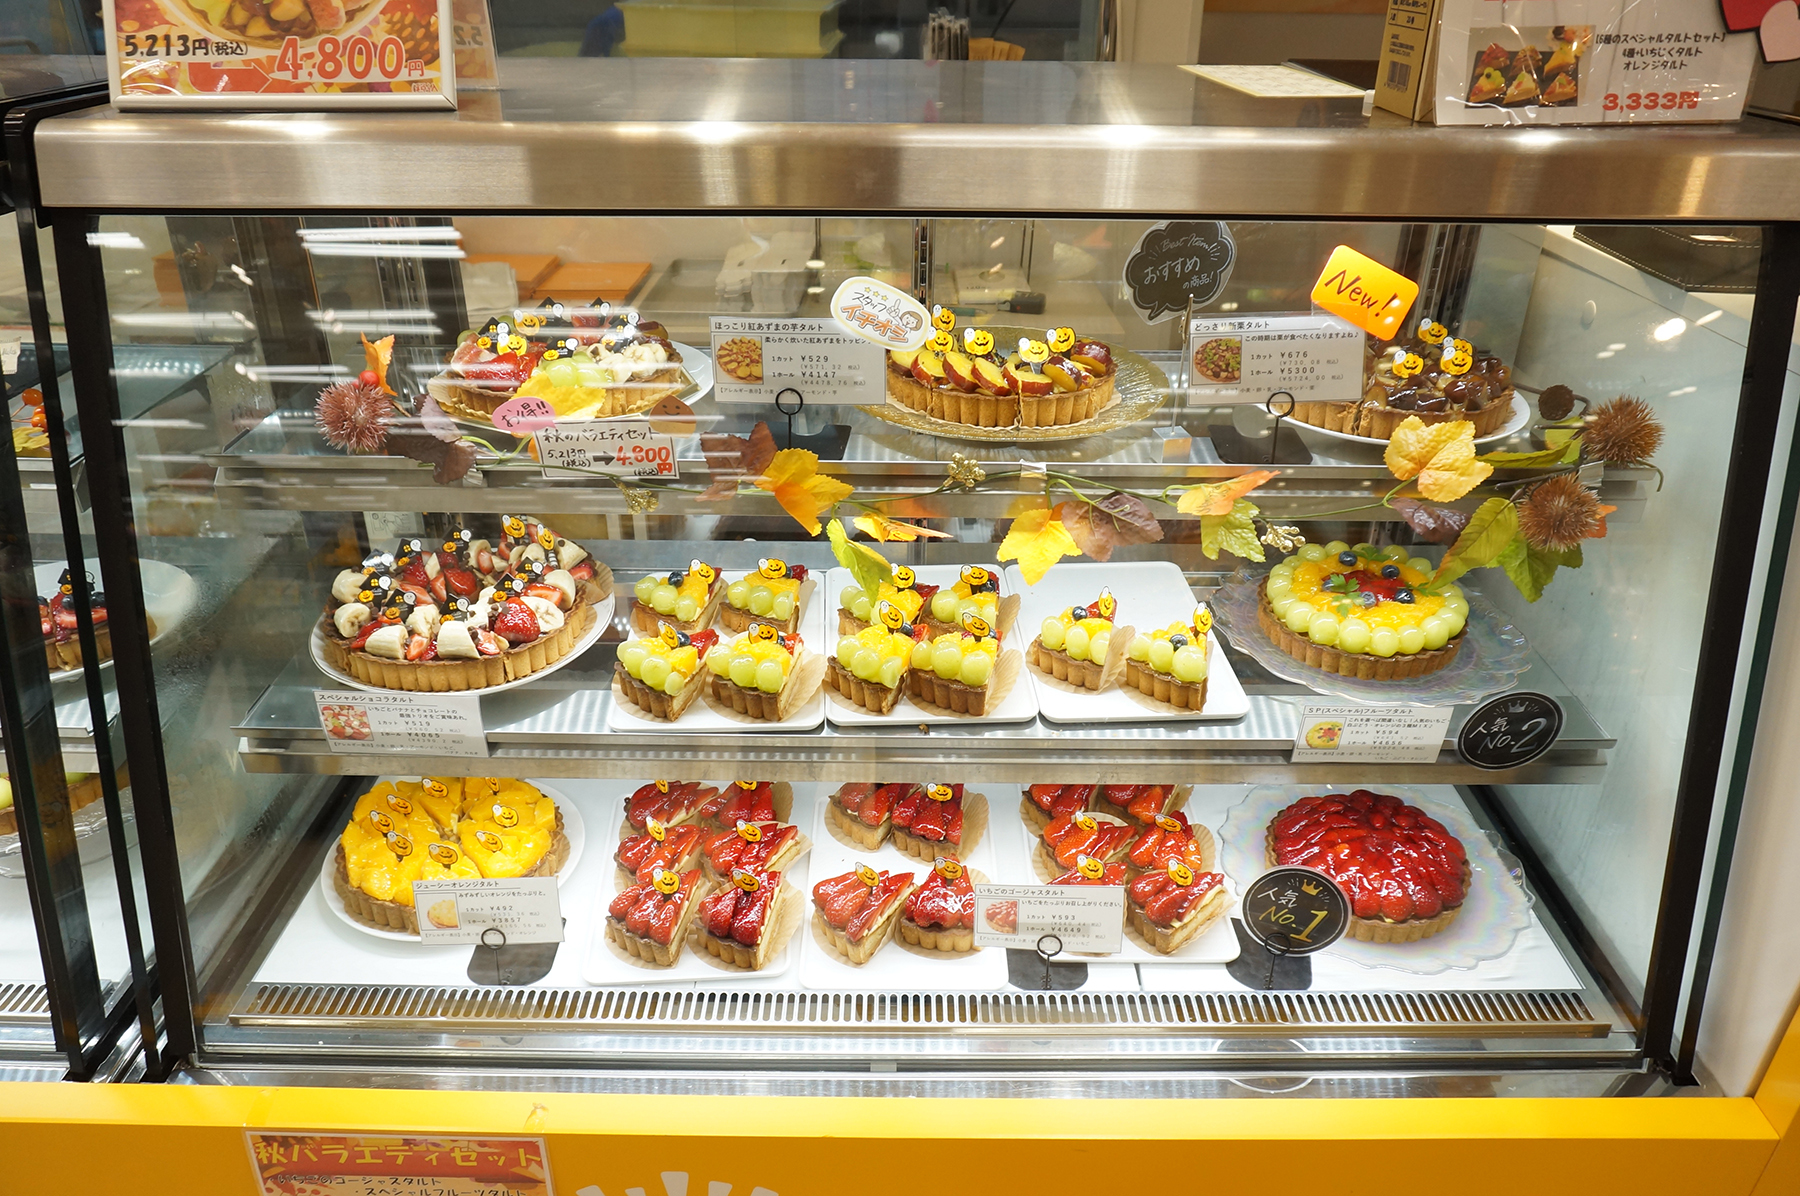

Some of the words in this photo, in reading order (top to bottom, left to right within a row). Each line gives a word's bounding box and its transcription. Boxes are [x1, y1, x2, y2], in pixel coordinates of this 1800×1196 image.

[1623, 60, 1688, 71] オレンジタルト
[1602, 91, 1700, 113] 3,333円
[1144, 256, 1200, 285] おすすめ
[1182, 271, 1214, 289] の商品!
[1324, 269, 1398, 317] New!
[852, 291, 887, 313] スタッフ
[714, 322, 824, 332] ほっこり紅あずまの芋タルト
[841, 304, 908, 343] イチオシ
[764, 336, 871, 345] 柔らかく炊いた紅あずまをトッピン
[800, 355, 829, 363] ¥529
[1280, 351, 1308, 359] ¥676
[1280, 367, 1315, 375] ¥5300
[542, 426, 661, 443] 秋のバラエティセット
[318, 694, 414, 704] スペシャルショコラタルト
[1469, 717, 1510, 738] 人気
[415, 881, 500, 890] ジューシーオレンジタルト
[978, 888, 1065, 896] いちごのゴージャスタルト
[1257, 887, 1299, 908] 人気
[255, 1142, 541, 1168] 秋バラエティセット
